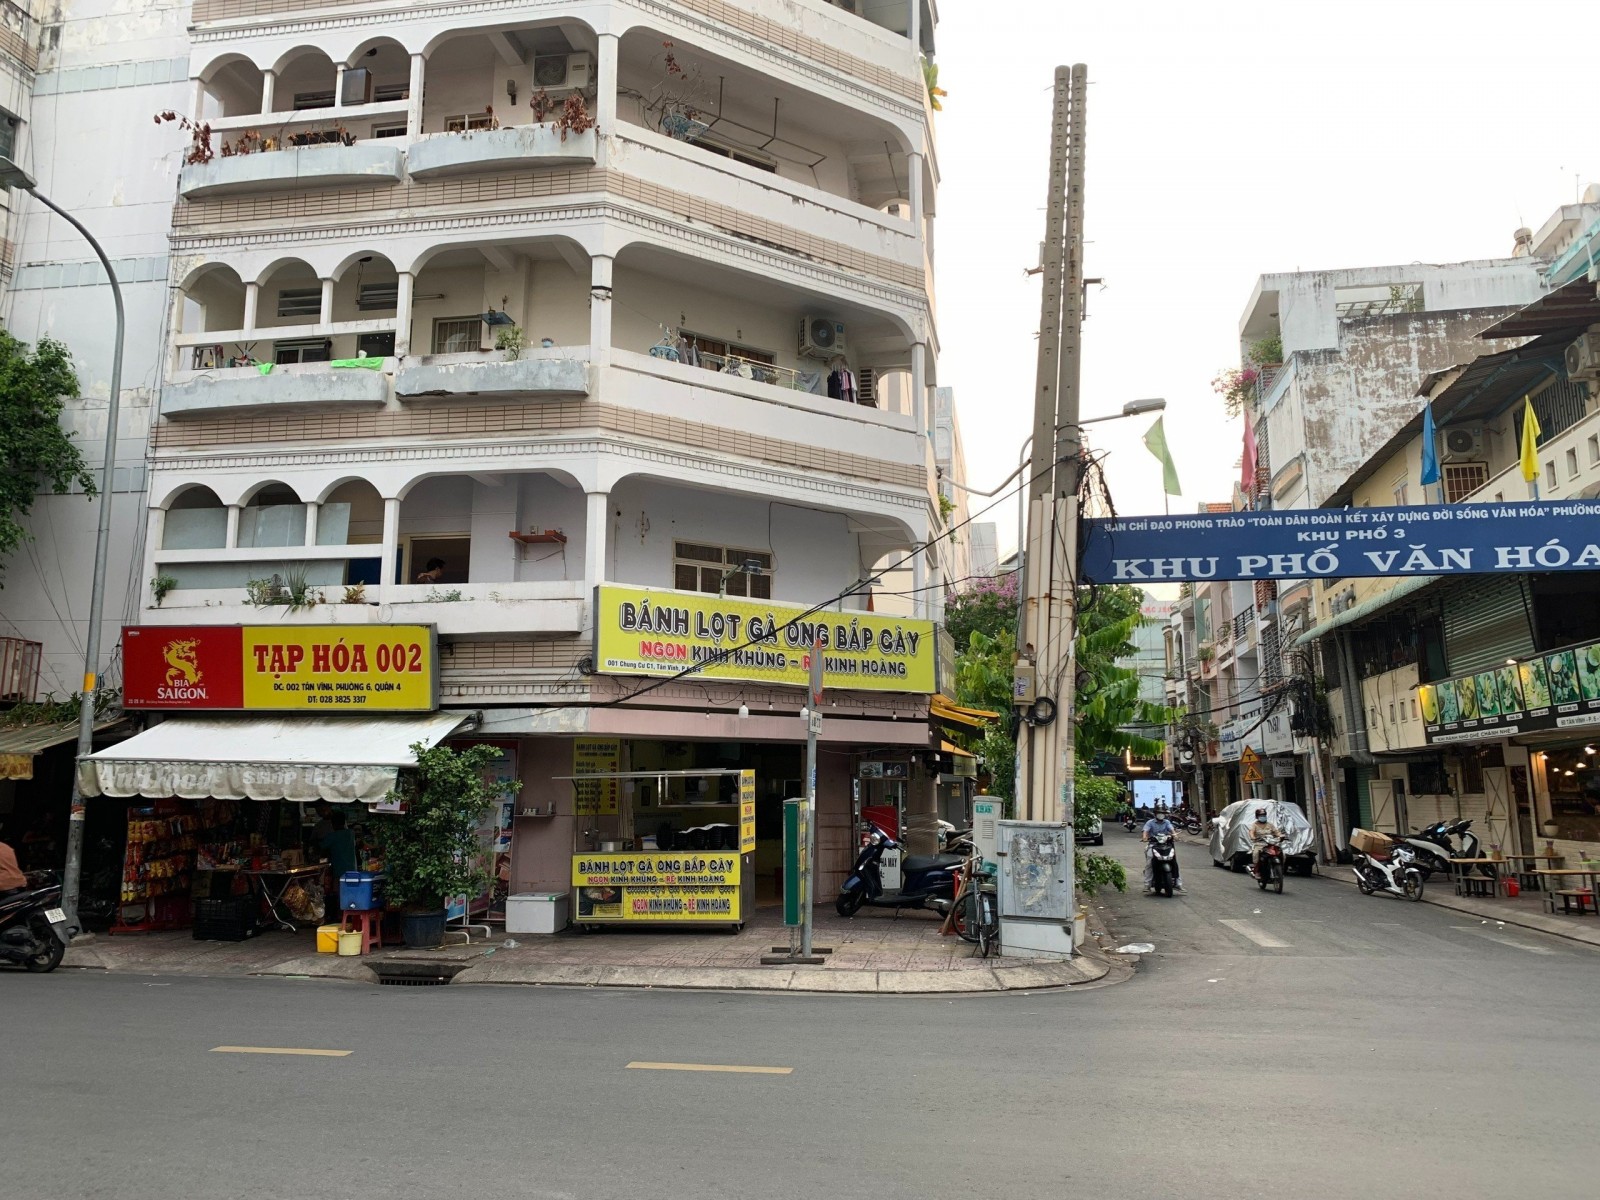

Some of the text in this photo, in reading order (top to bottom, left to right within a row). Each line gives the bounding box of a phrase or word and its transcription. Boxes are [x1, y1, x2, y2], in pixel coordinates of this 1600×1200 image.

[1129, 518, 1148, 531] CHỈ
[1150, 520, 1173, 533] ĐẠO
[1175, 519, 1213, 530] PHONG
[1215, 515, 1245, 528] TRÀO
[1286, 514, 1309, 525] DÂN
[1311, 512, 1342, 525] ĐOÀN
[1345, 510, 1368, 523] KẾT
[1372, 511, 1394, 523] XÂY
[1398, 510, 1430, 524] DỰNG
[1433, 508, 1453, 520] ĐỜI
[1456, 506, 1489, 519] SỐNG
[1491, 506, 1516, 518] VĂN
[1297, 524, 1405, 542] KHU PHỐ 3
[1112, 538, 1600, 580] KHU PHỐ VĂN HÓA
[620, 598, 690, 636] BÁNH
[695, 610, 741, 644] LỌT
[746, 612, 778, 646] GÀ
[784, 621, 830, 649] ONG
[878, 624, 920, 656] CÀY
[253, 637, 423, 679] TẠP HÓA 002
[607, 659, 618, 667] 001
[619, 660, 637, 669] Chung
[639, 640, 688, 660] NGON
[691, 645, 729, 664] KINH
[734, 646, 787, 669] KHỦNG
[825, 656, 857, 675] KINH
[860, 657, 907, 676] HOÀNG
[174, 679, 190, 688] BIA
[286, 683, 300, 691] 002
[396, 683, 402, 691] 4
[157, 687, 206, 700] SAIGON
[319, 695, 333, 704] 028
[335, 695, 351, 703] 3825
[579, 858, 610, 874] BÁNH
[613, 860, 634, 876] LỌT
[638, 858, 654, 873] GÀ
[657, 859, 681, 873] ONG
[709, 857, 734, 873] CÀY
[587, 876, 609, 885] NGON
[610, 875, 629, 885] KINH
[630, 873, 659, 884] KHỦNG
[677, 875, 696, 884] KINH
[698, 873, 726, 884] HOÀNG
[632, 898, 648, 912] NGON
[648, 898, 663, 912] KINH
[697, 898, 710, 912] KINH
